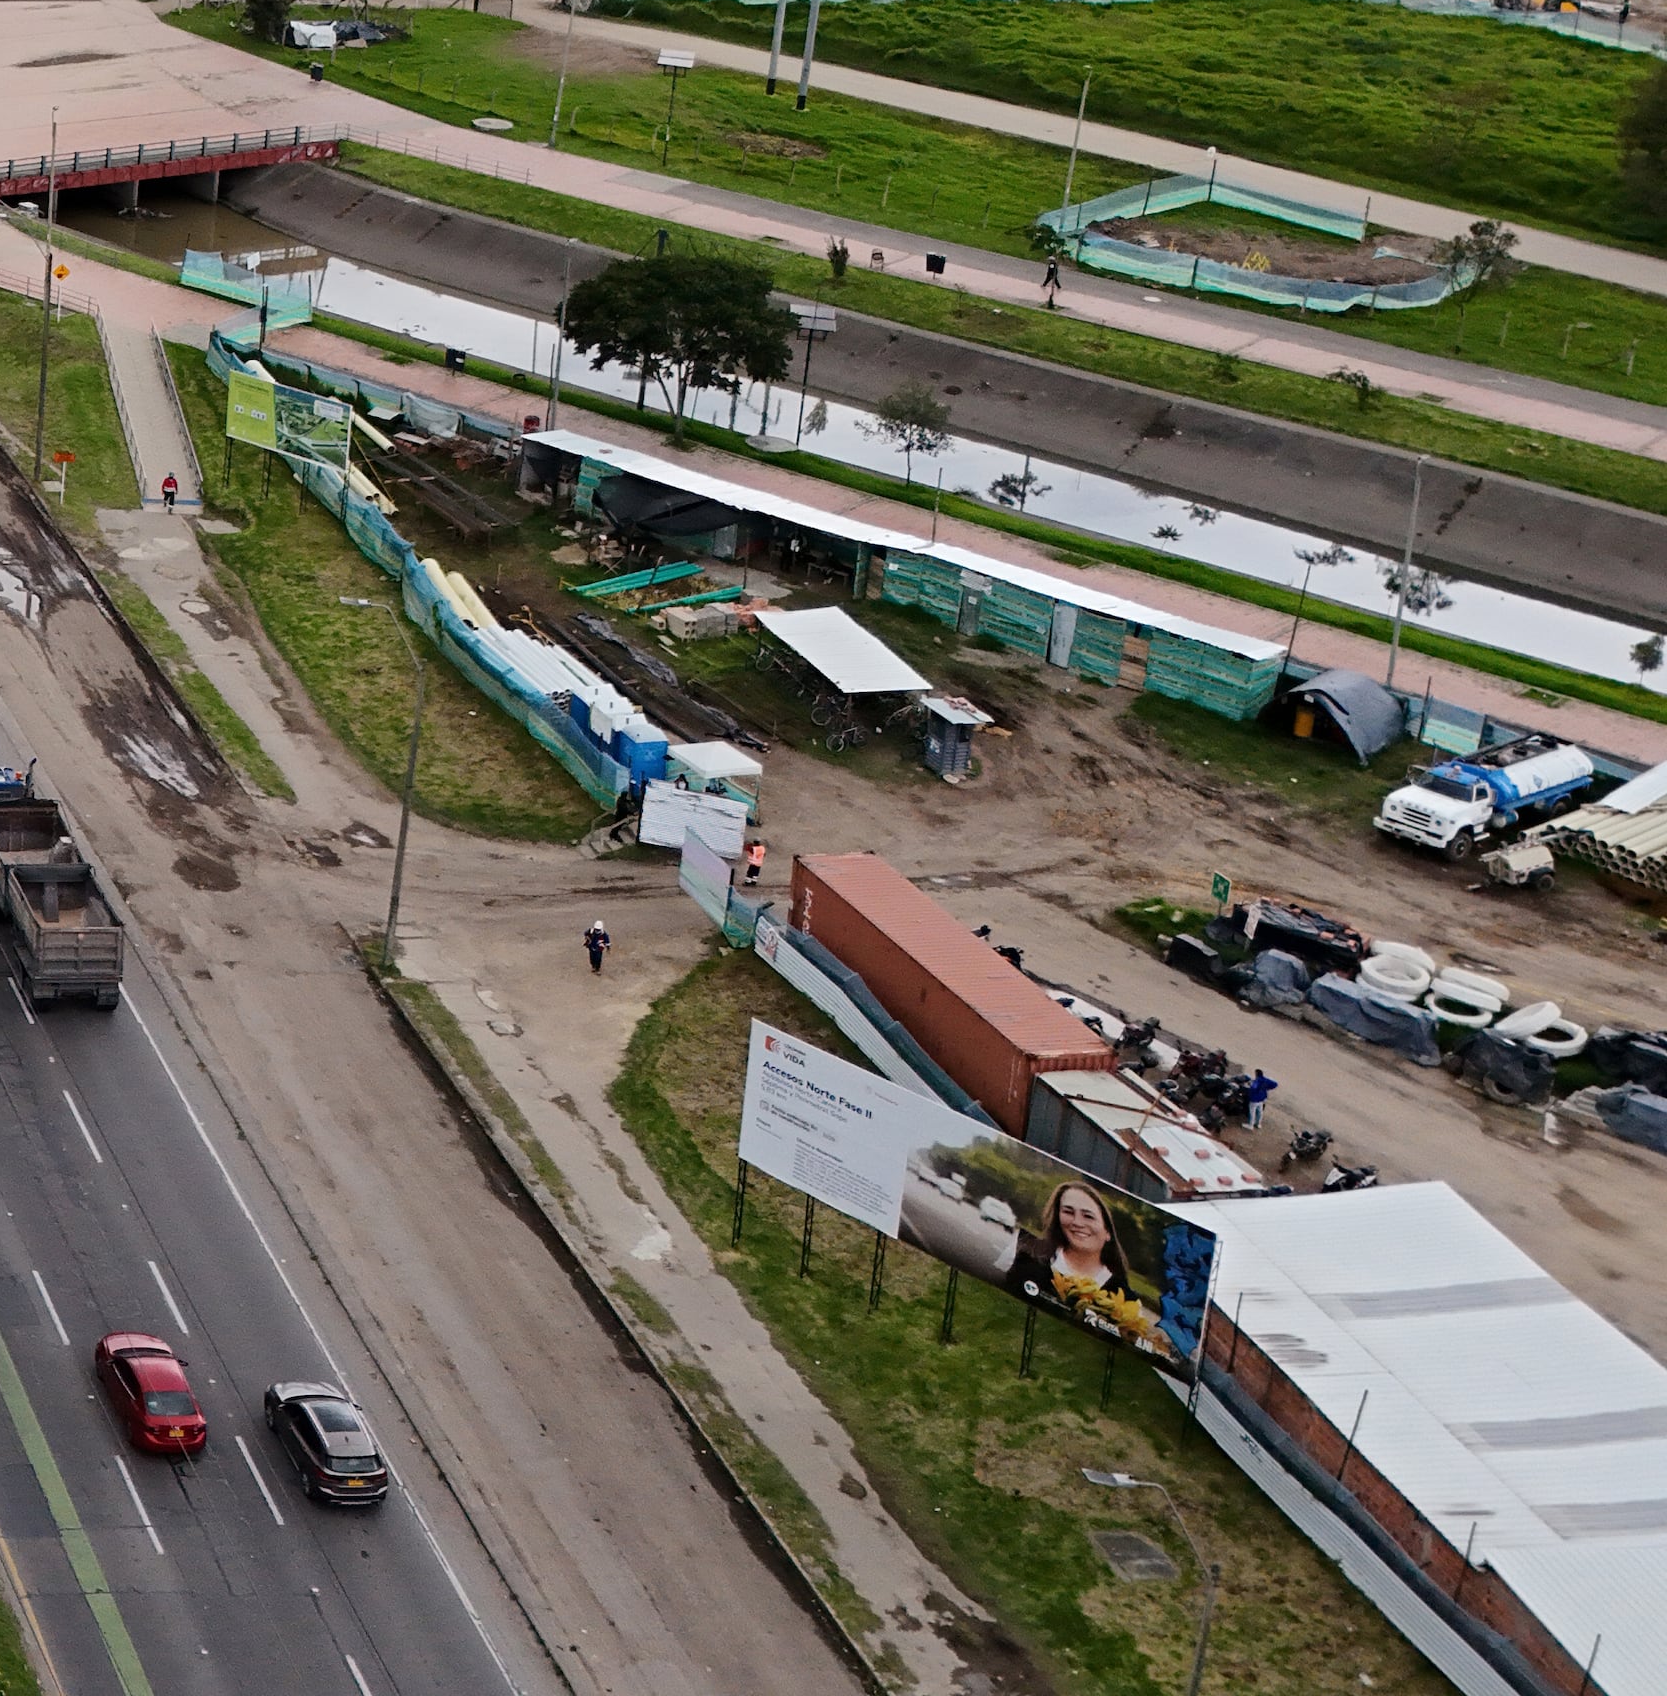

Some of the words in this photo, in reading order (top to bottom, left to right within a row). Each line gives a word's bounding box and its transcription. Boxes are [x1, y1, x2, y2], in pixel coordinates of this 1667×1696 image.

[782, 1052, 805, 1068] VIDA
[763, 1060, 803, 1086] Accesos
[805, 1080, 836, 1102] Norte
[839, 1096, 862, 1115] Fase
